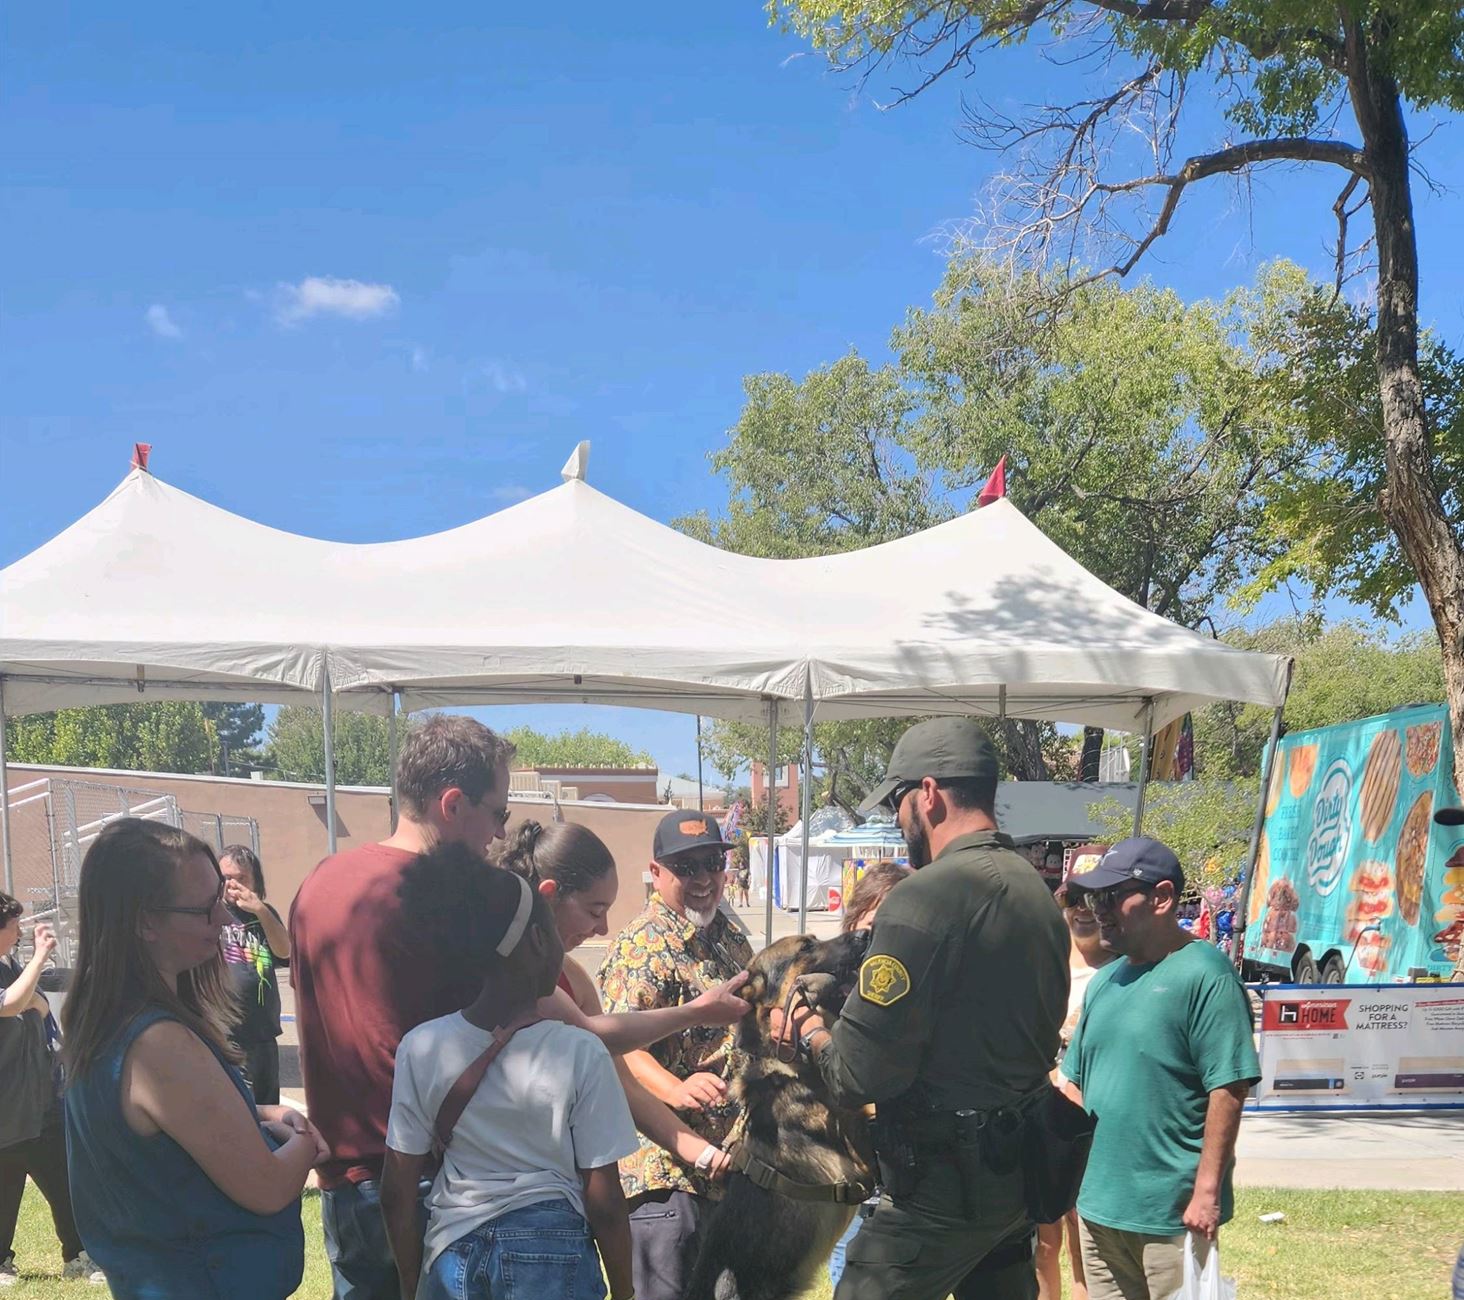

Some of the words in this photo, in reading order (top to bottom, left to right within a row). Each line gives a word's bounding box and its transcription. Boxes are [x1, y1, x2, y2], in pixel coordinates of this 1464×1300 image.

[1316, 790, 1343, 828] Dirty
[1309, 834, 1342, 867] Dough
[1359, 1004, 1409, 1013] SHOPPING
[1301, 1007, 1337, 1024] HOME
[1369, 1013, 1389, 1021] FOR
[1390, 1013, 1397, 1021] A
[1355, 1021, 1408, 1030] MATTRESS?
